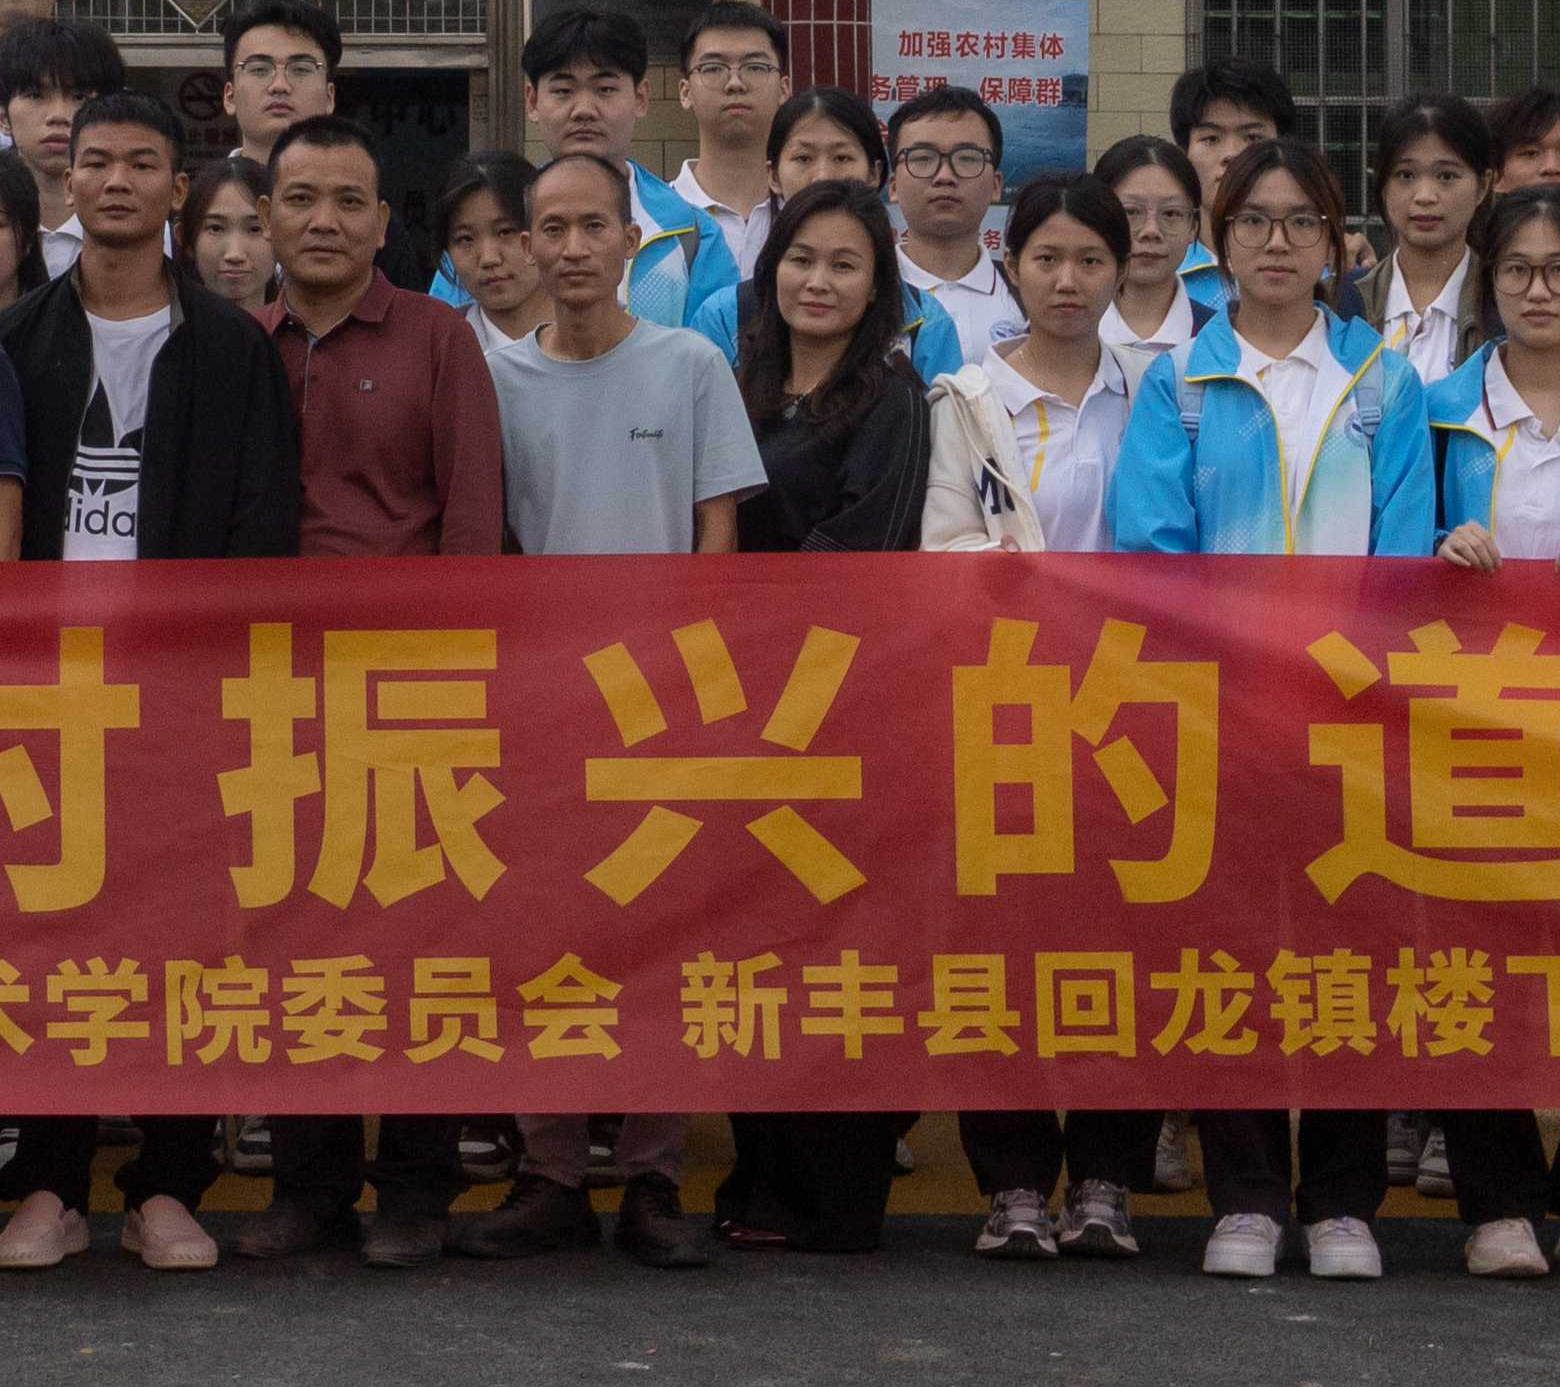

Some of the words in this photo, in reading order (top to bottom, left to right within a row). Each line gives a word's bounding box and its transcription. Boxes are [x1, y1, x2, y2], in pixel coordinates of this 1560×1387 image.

[898, 30, 1065, 60] 加强农村集体
[979, 75, 1064, 105] 保障群
